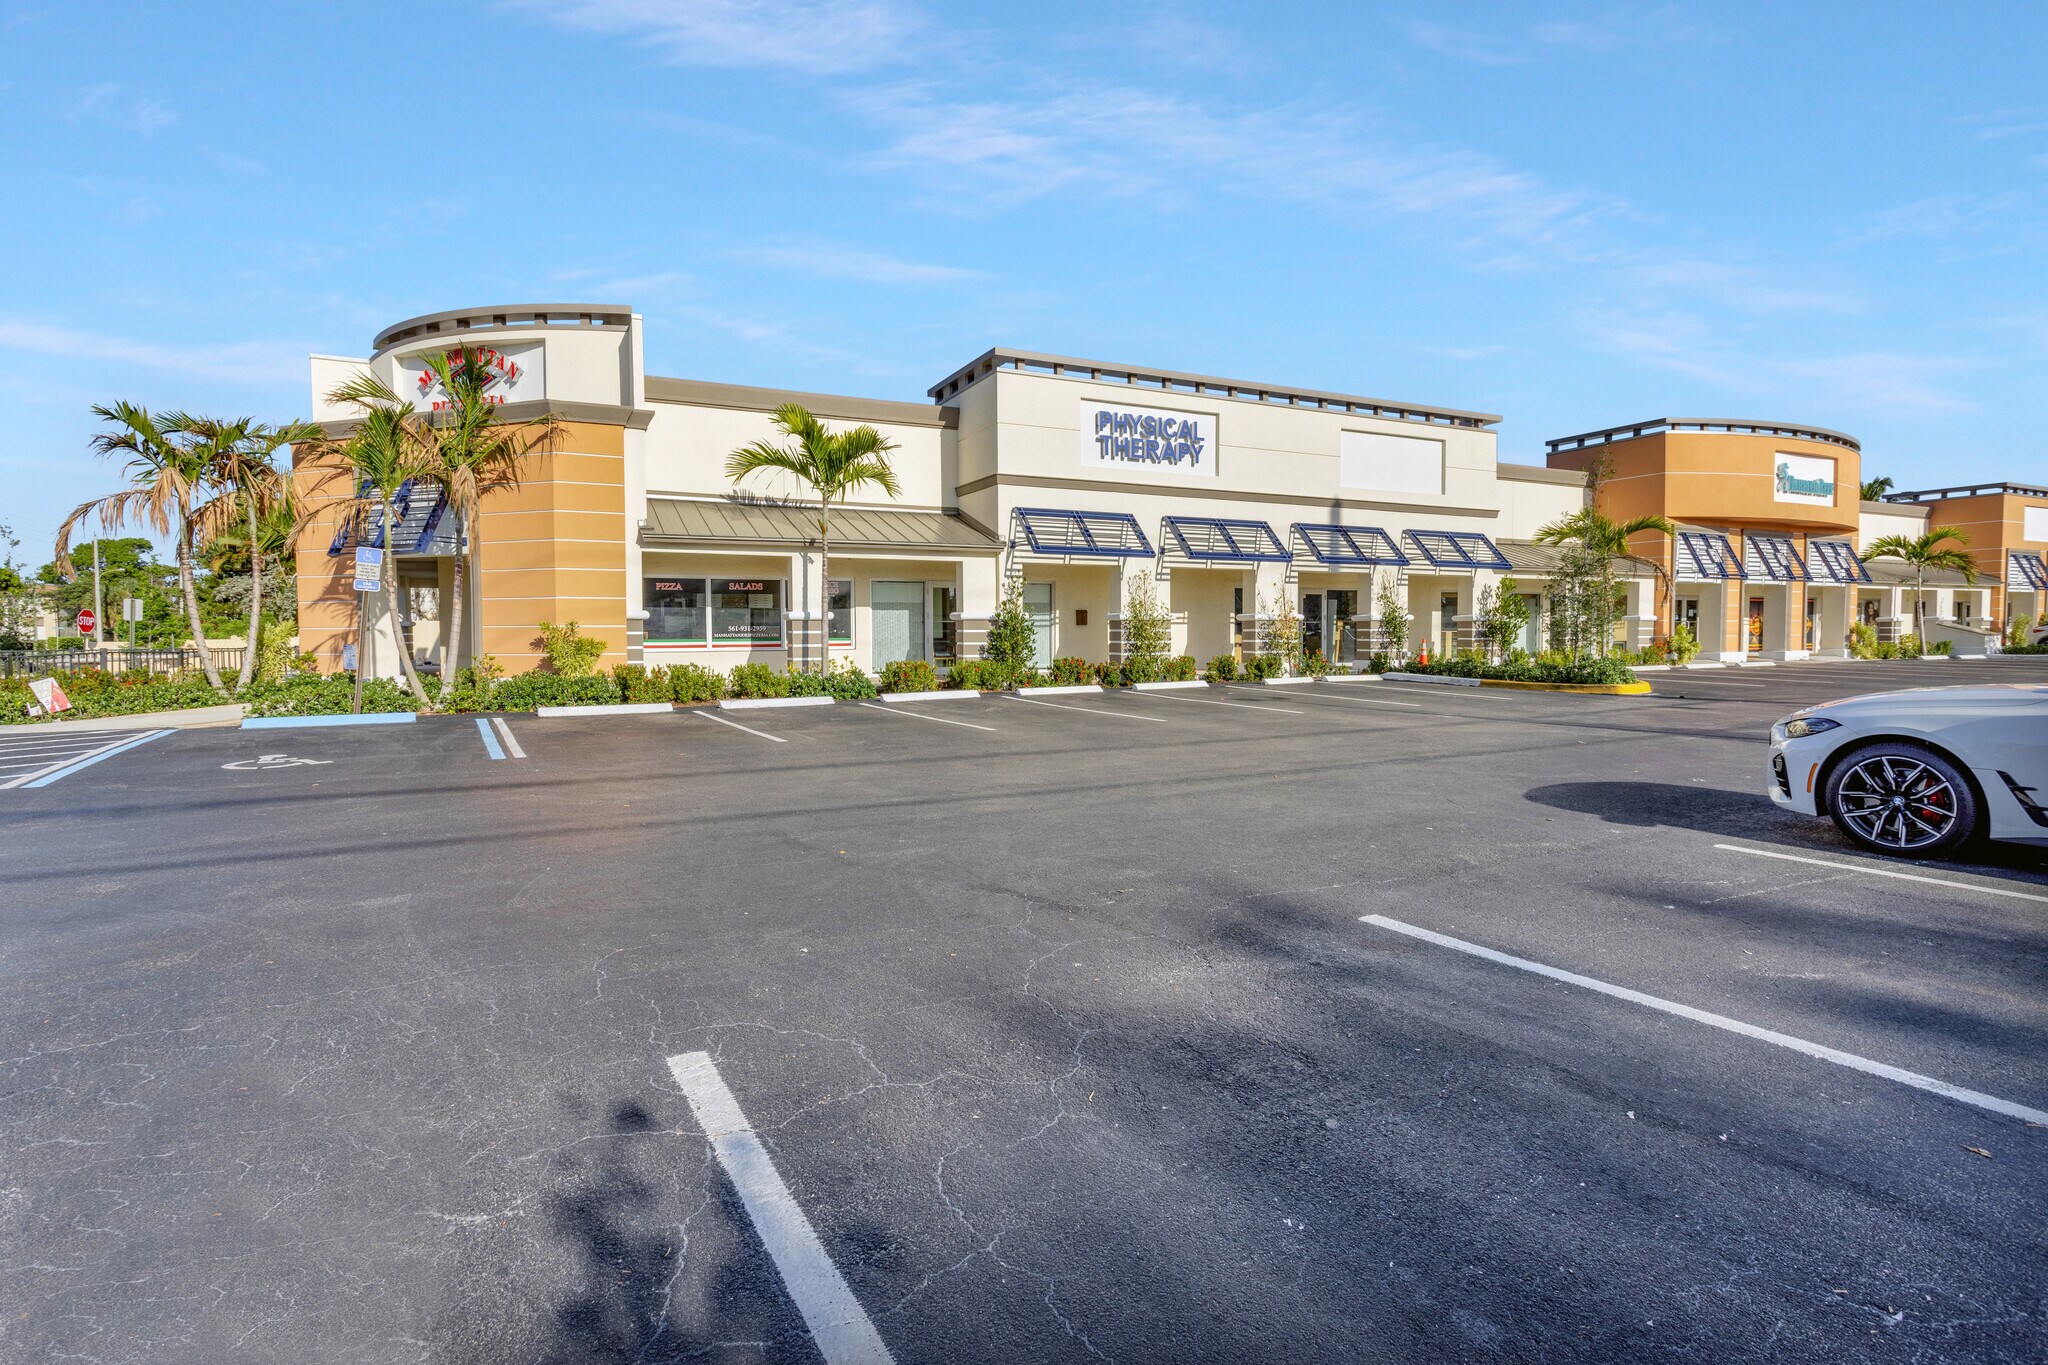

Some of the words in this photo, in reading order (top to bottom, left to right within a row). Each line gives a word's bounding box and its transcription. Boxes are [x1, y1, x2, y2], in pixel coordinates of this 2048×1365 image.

[1097, 410, 1205, 442] PHYSICAL
[1097, 435, 1205, 464] THERAPY
[655, 582, 684, 591] PIZZA
[728, 582, 763, 591] SALADS
[78, 616, 95, 626] STOP
